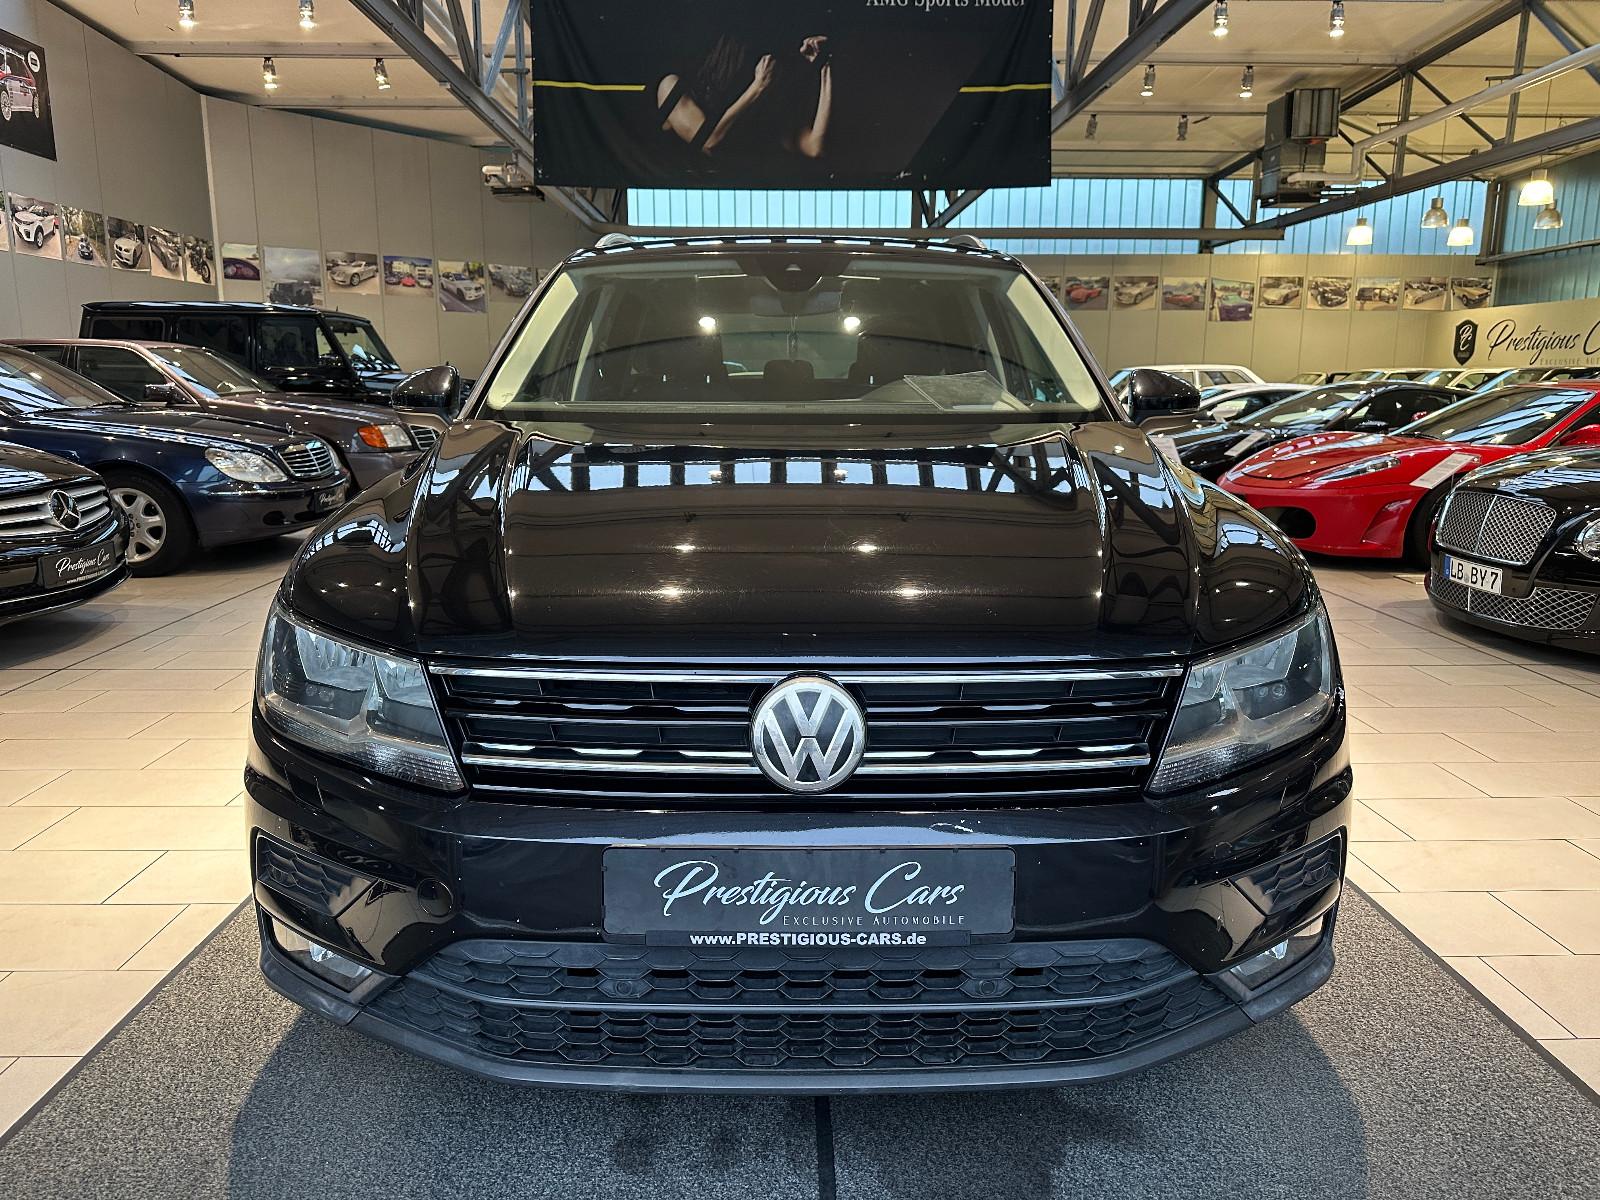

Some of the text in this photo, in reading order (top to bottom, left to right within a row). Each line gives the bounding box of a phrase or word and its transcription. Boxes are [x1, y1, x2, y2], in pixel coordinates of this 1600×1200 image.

[914, 0, 969, 12] Sports
[1486, 318, 1580, 366] Prestigious
[1450, 559, 1499, 590] LB BY 7
[653, 860, 965, 925] Prestigious Cars
[783, 915, 966, 926] EXCLUSIVE AUTOMOBILE
[689, 932, 927, 946] www.PRESTIGIOUS-CARS.de
